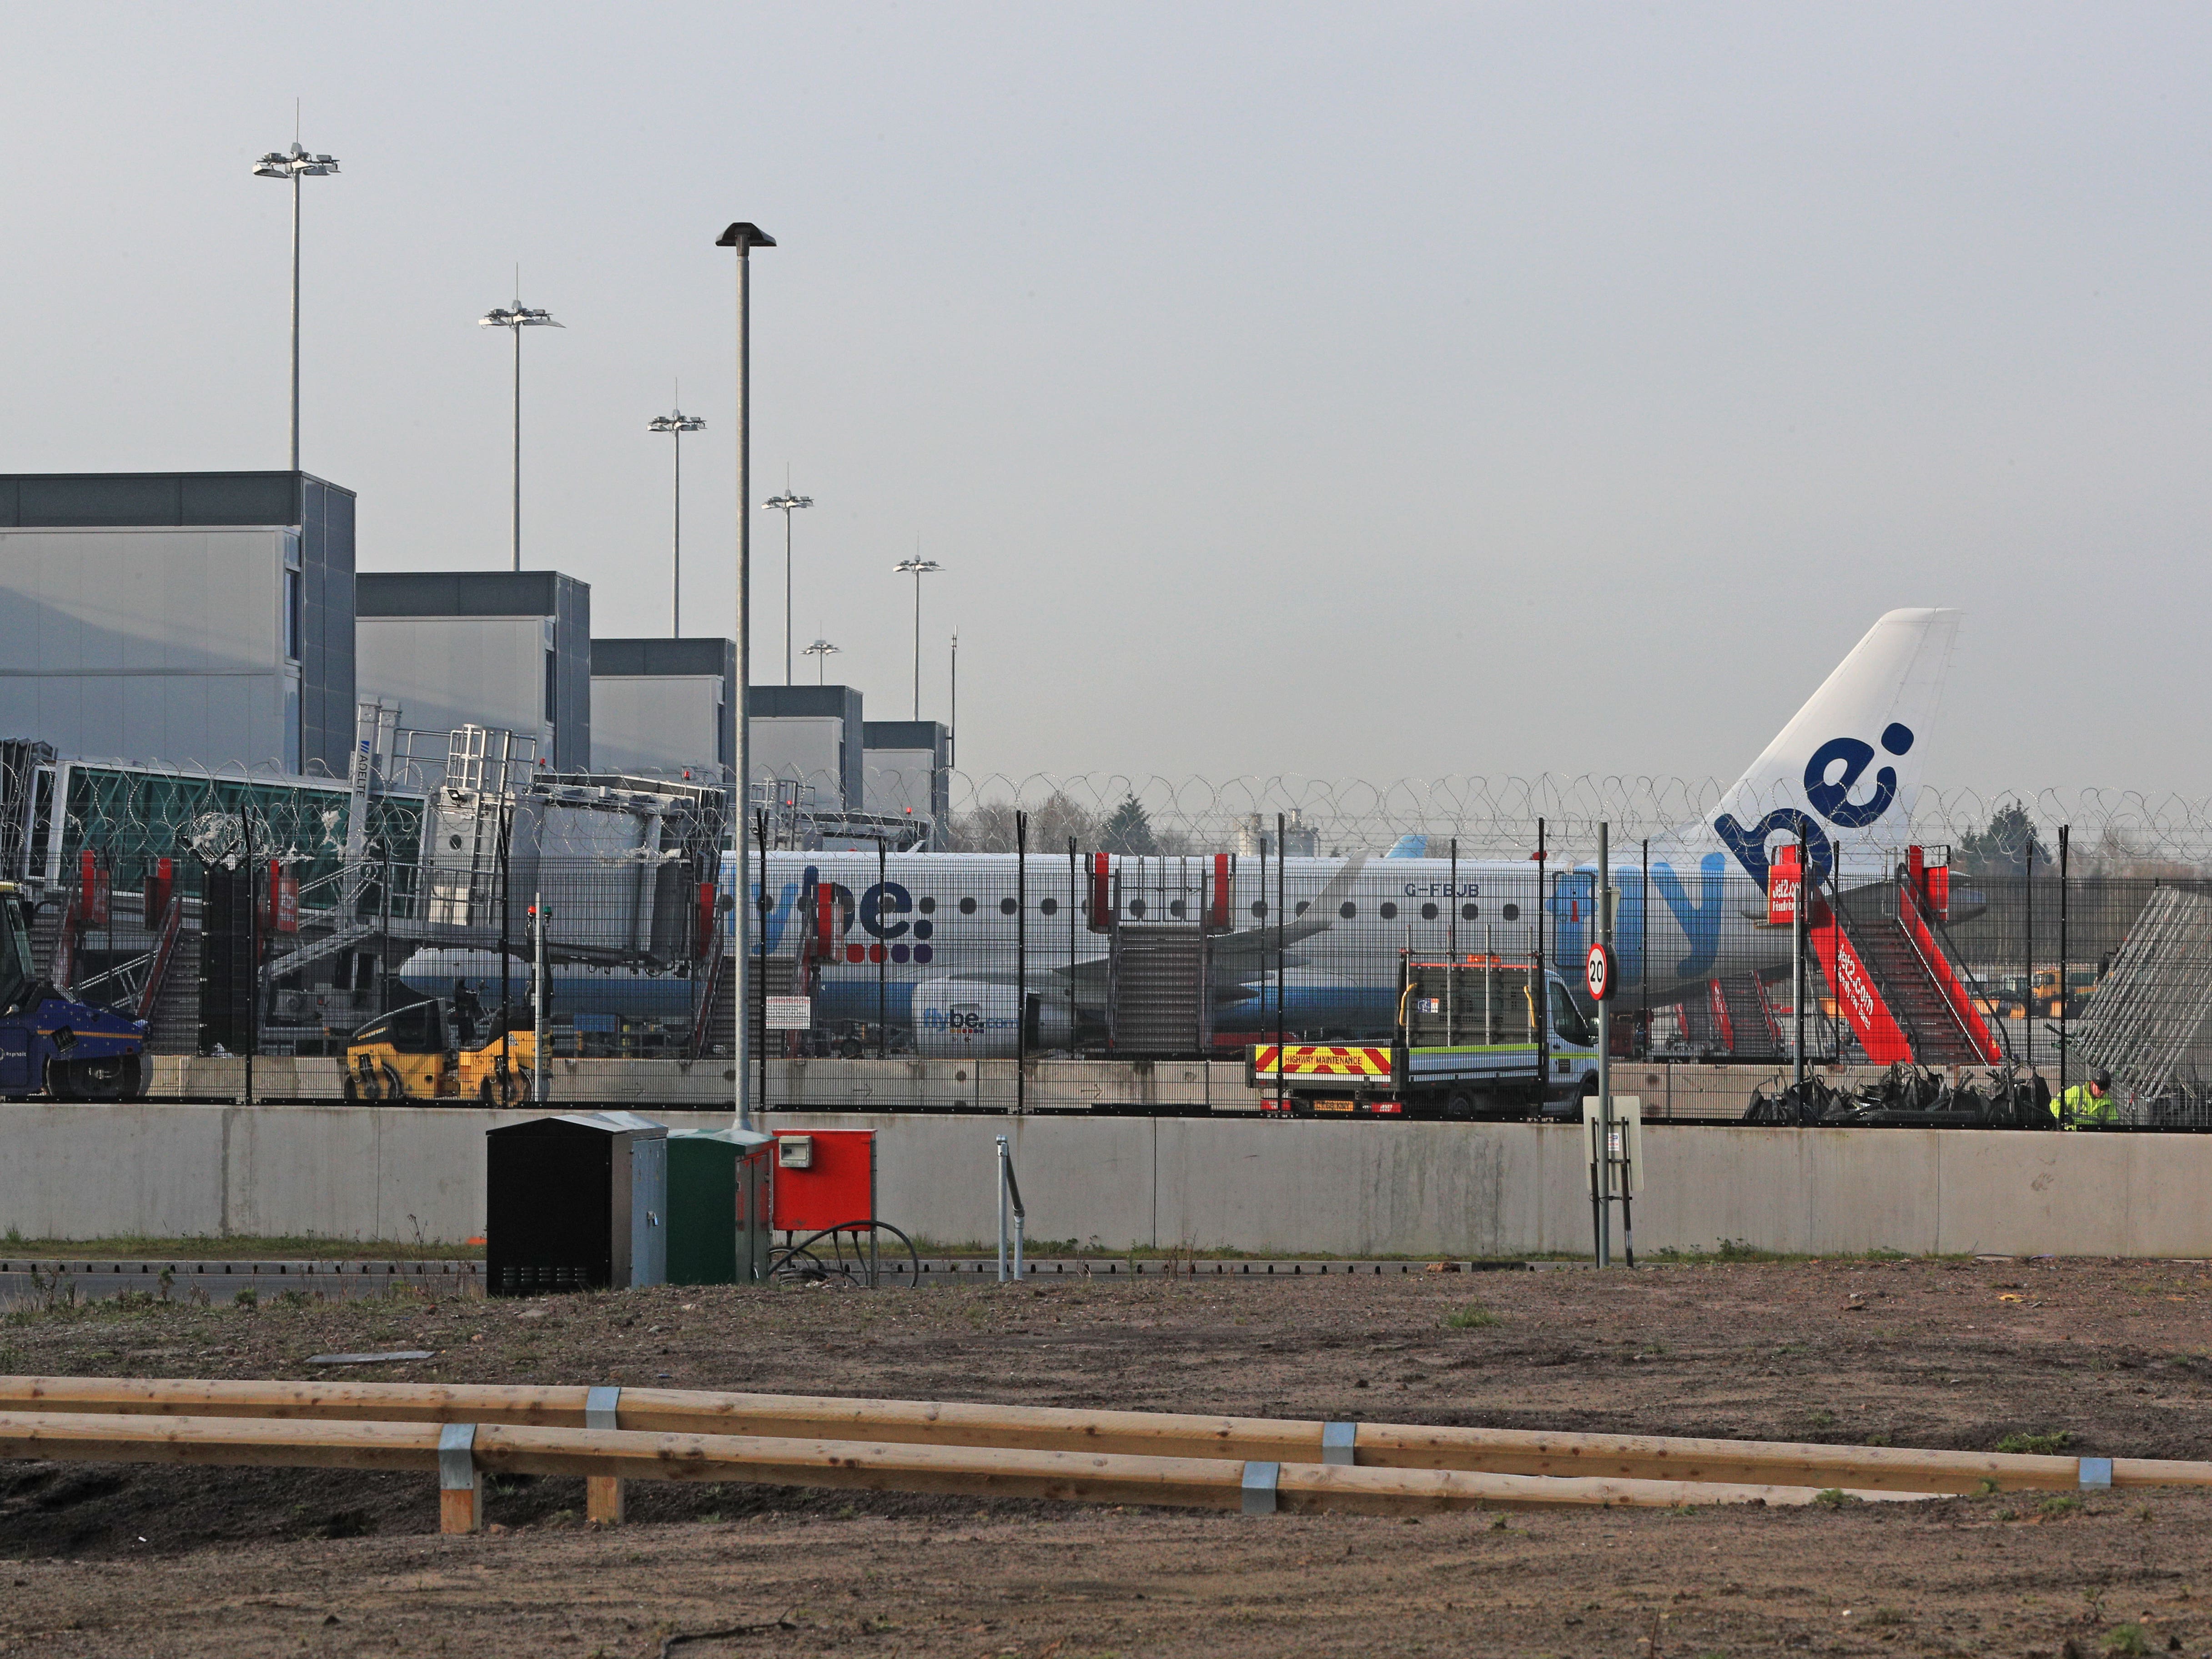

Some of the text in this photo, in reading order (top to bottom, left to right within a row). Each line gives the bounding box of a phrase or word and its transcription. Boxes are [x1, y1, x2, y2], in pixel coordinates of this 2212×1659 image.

[356, 754, 368, 798] ADELTE
[1405, 884, 1479, 897] G-FBJB
[1590, 960, 1603, 983] 20
[1286, 1056, 1361, 1065] HIGHWAY MAINTENANCE
